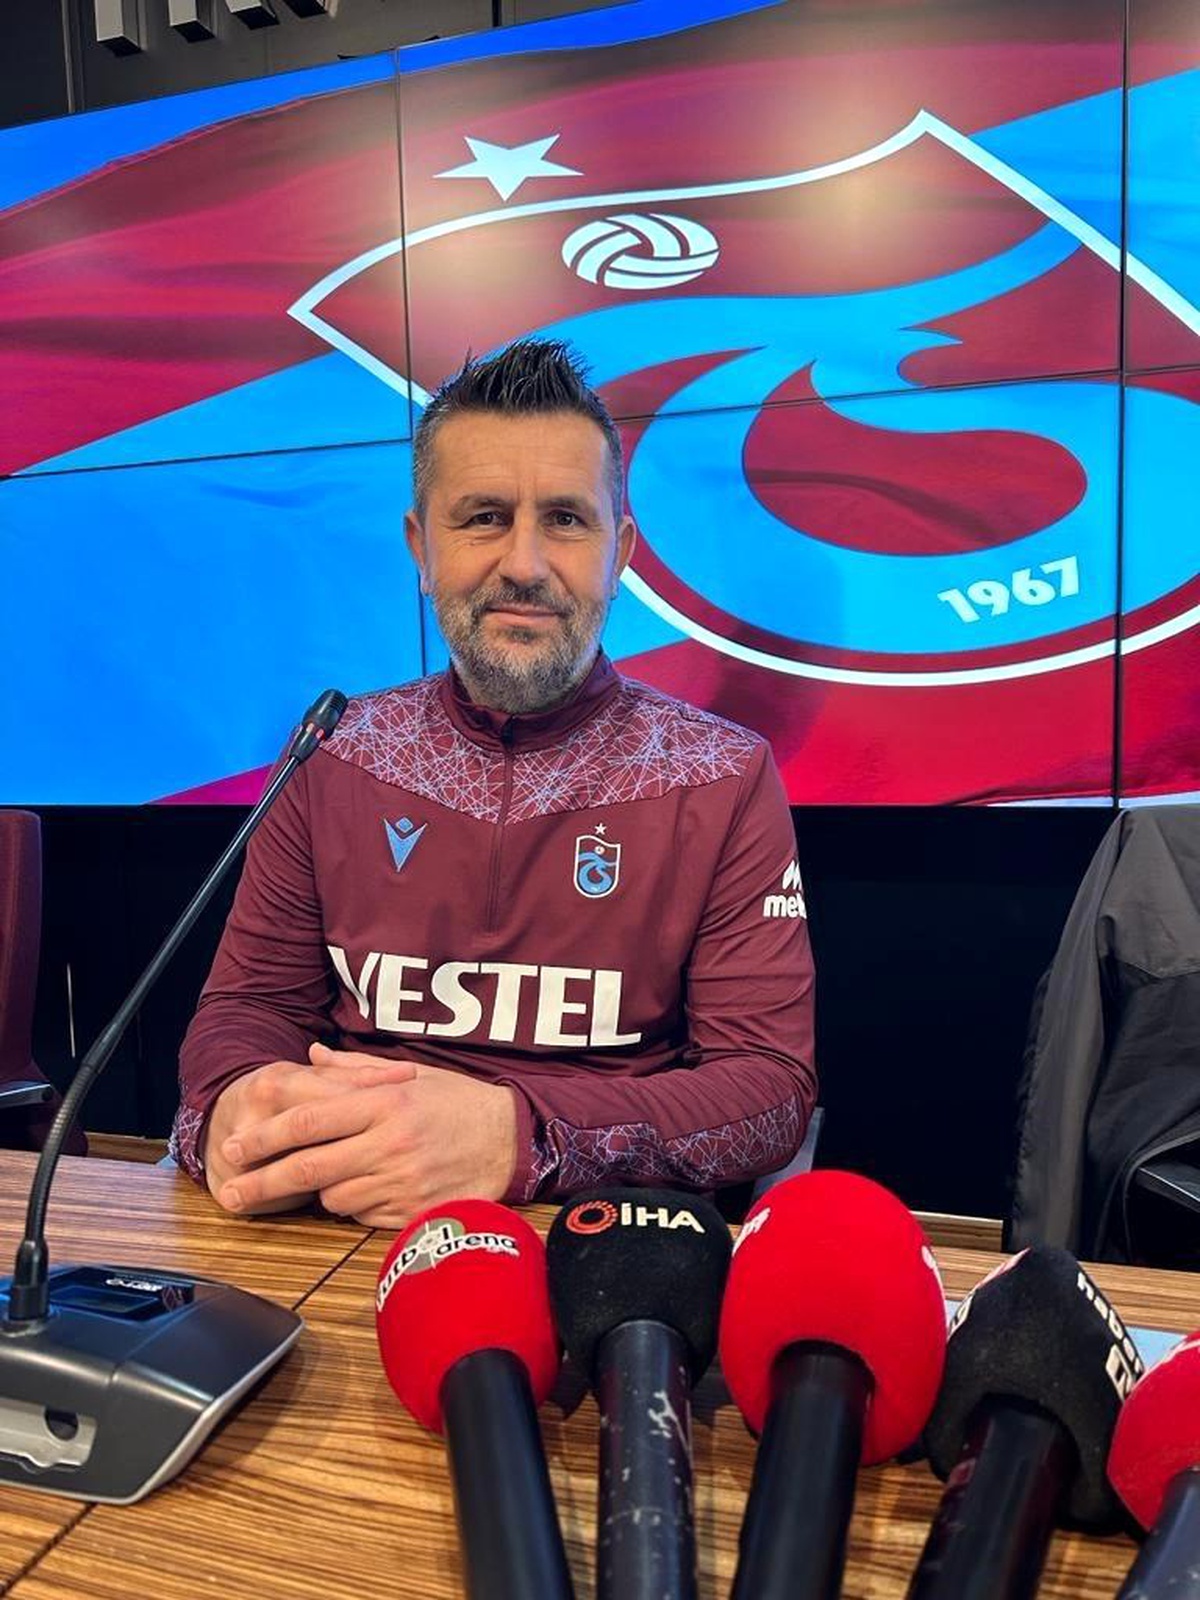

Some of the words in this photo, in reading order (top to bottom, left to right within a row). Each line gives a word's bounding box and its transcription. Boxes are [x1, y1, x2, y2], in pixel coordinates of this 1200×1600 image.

[937, 555, 1079, 623] 1967
[327, 945, 642, 1046] VESTEL
[434, 1233, 518, 1257] arena
